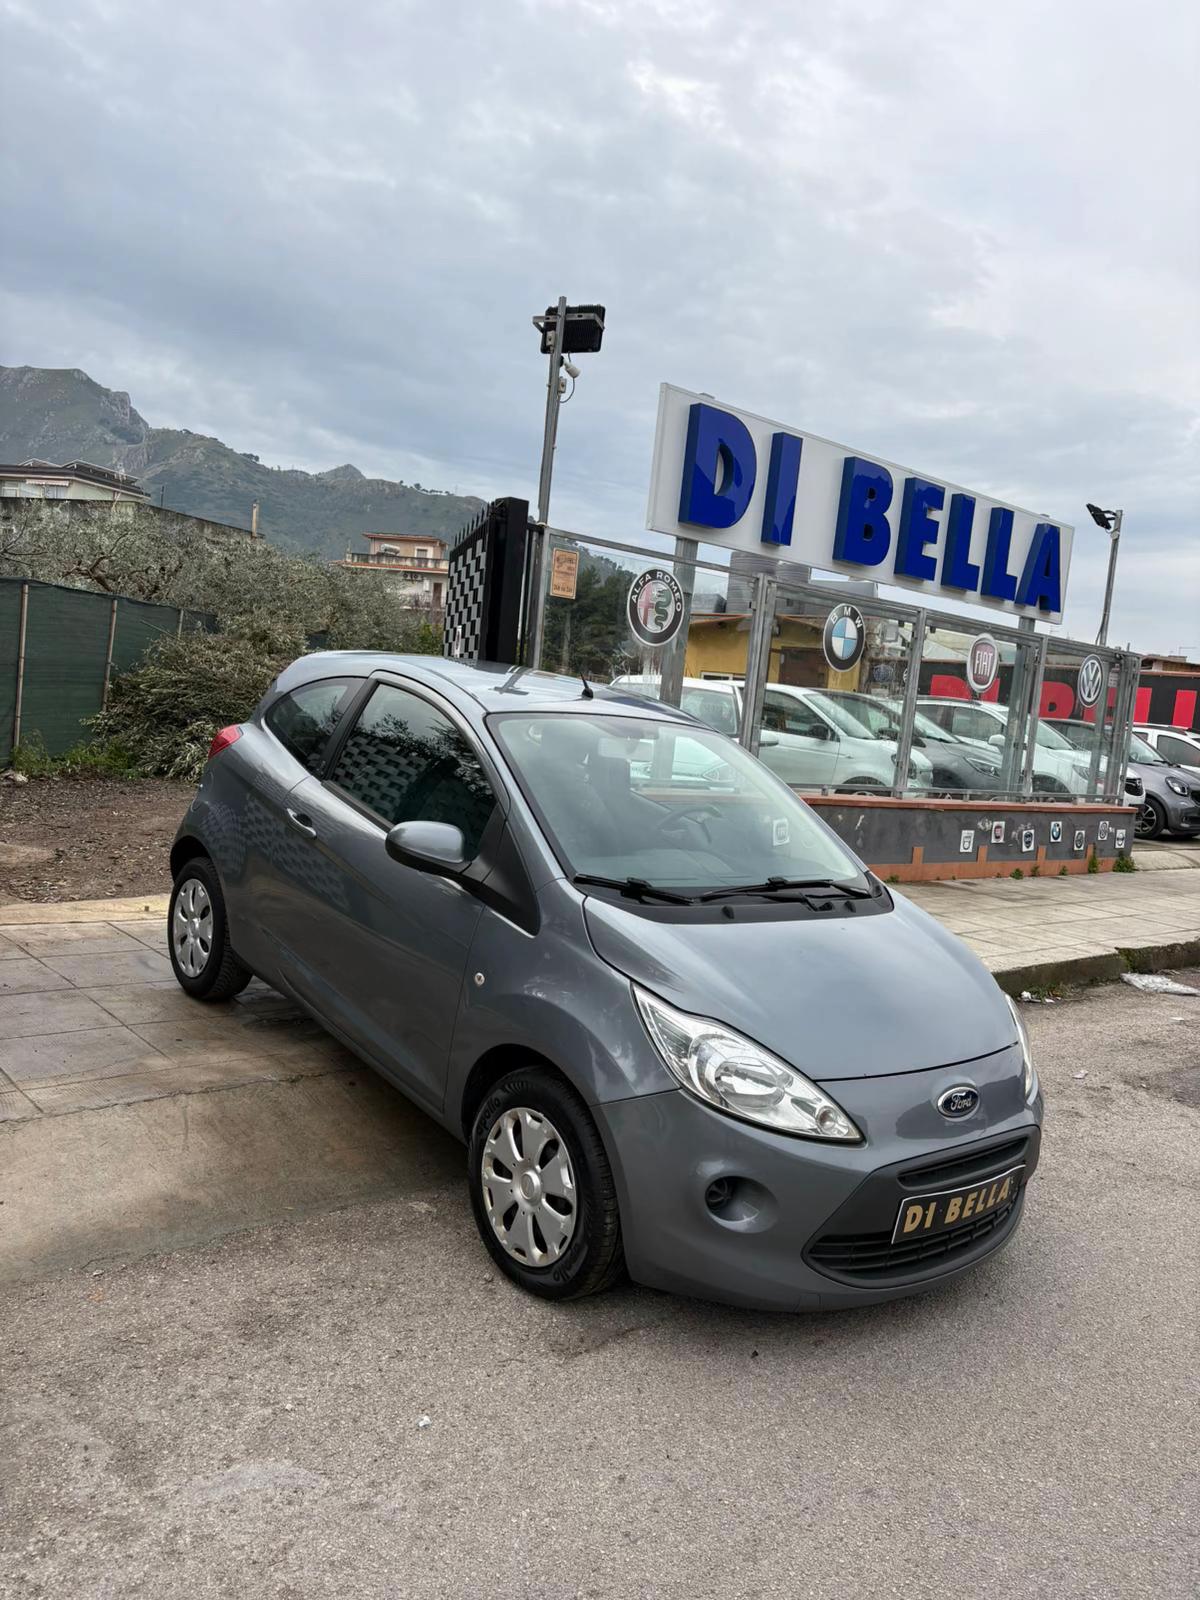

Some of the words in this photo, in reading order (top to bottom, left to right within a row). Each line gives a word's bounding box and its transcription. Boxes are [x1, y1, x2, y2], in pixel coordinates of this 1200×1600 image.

[678, 402, 803, 546] DI
[833, 456, 1061, 612] BELLA
[631, 573, 652, 604] ALFA
[656, 571, 682, 612] ROMEO
[974, 650, 993, 677] FIAT
[950, 1093, 973, 1110] Ford
[903, 1202, 937, 1233] DI
[944, 1178, 1011, 1224] BELLA
